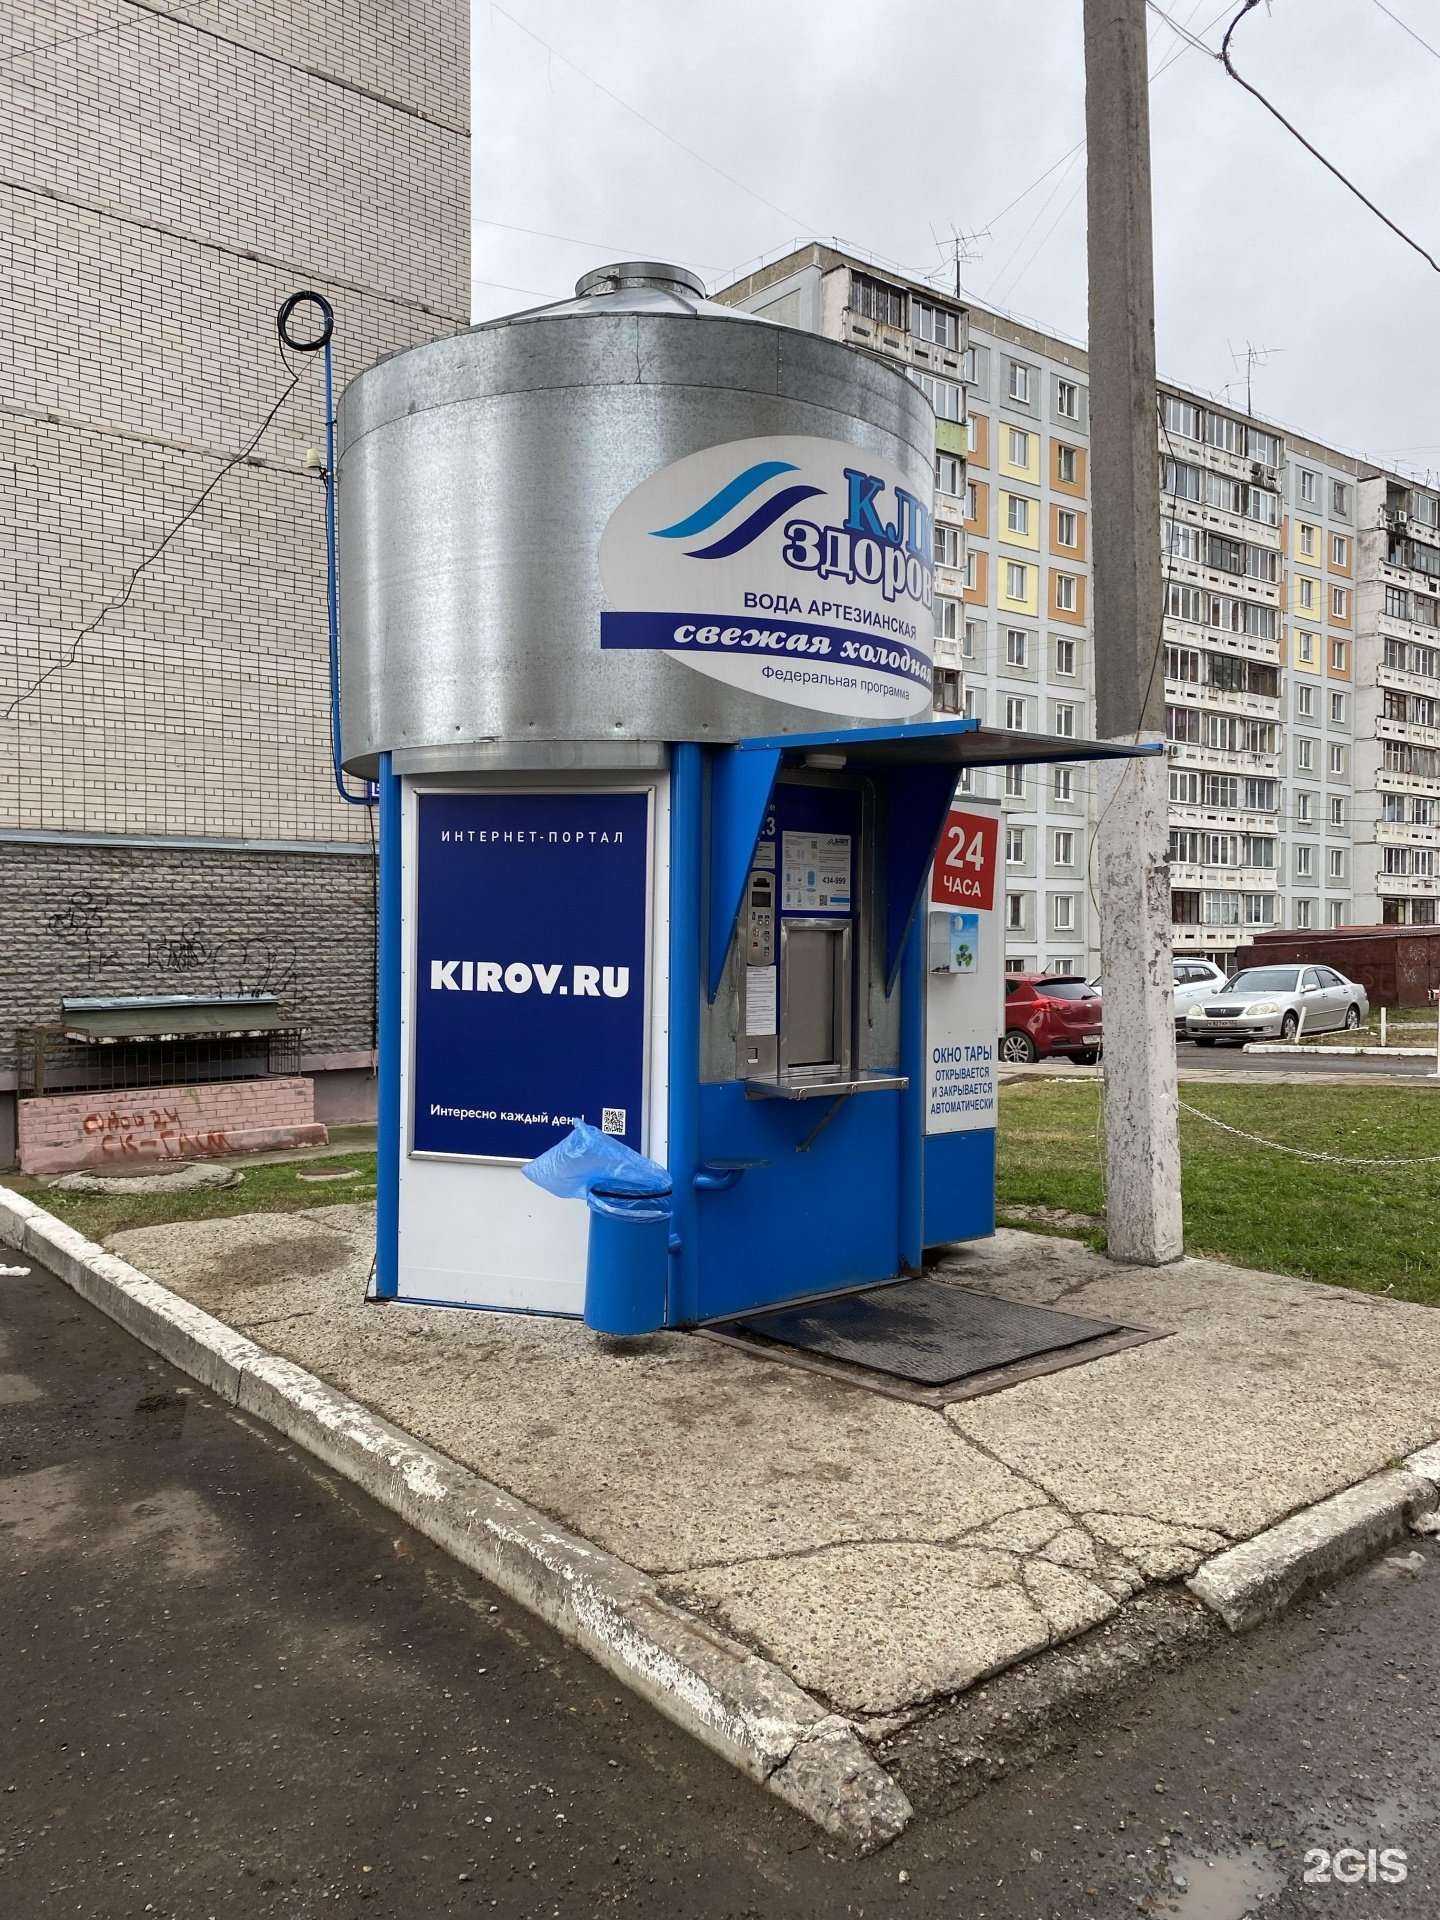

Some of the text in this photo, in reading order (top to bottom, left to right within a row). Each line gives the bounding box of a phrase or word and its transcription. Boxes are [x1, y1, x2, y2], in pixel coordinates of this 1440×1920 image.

[744, 592, 917, 640] ВОДА АРТЕЗИАНСКАЯ
[673, 624, 832, 655] свежая
[762, 665, 910, 701] Федеральная программа
[441, 830, 624, 844] ИНТЕРНЕТ-ПОРТАЛ
[945, 826, 984, 871] 24
[943, 875, 982, 898] ЧАСА
[430, 960, 630, 998] KIROV.RU
[933, 1045, 992, 1063] ОКНО ТАРЫ
[935, 1066, 990, 1081] ОТКРЫВАЕТСЯ
[932, 1082, 993, 1098] И ЗАКРЫВАЕТСЯ
[430, 1103, 497, 1121] Интересно
[500, 1112, 549, 1125] каждый
[930, 1098, 994, 1115] АВТОМАТИЧЕСКИ
